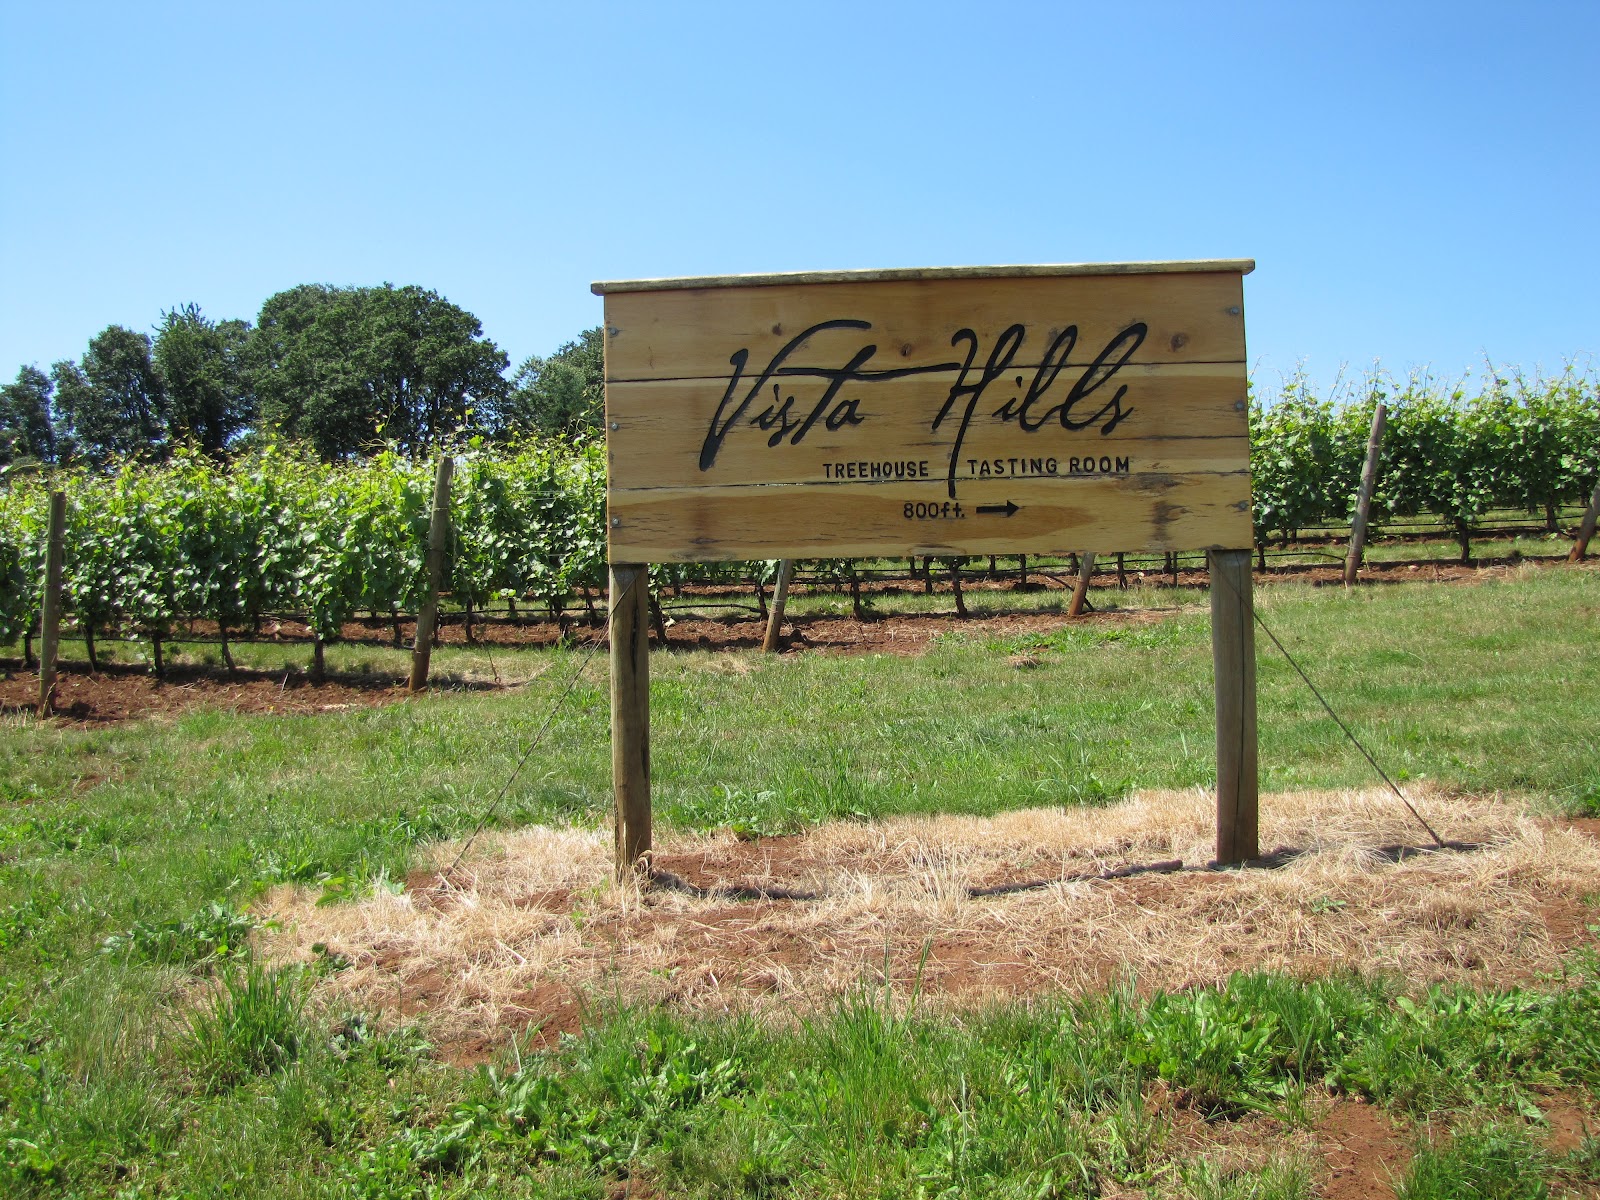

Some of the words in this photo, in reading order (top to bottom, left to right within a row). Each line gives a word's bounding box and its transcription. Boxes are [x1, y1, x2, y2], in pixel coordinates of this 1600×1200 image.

[699, 319, 960, 472] Vista
[931, 322, 1148, 499] Hills
[822, 460, 929, 479] TREEHOUSE
[967, 457, 1058, 475] TASTING
[1069, 455, 1130, 473] ROOM
[903, 501, 966, 519] 800ft.
